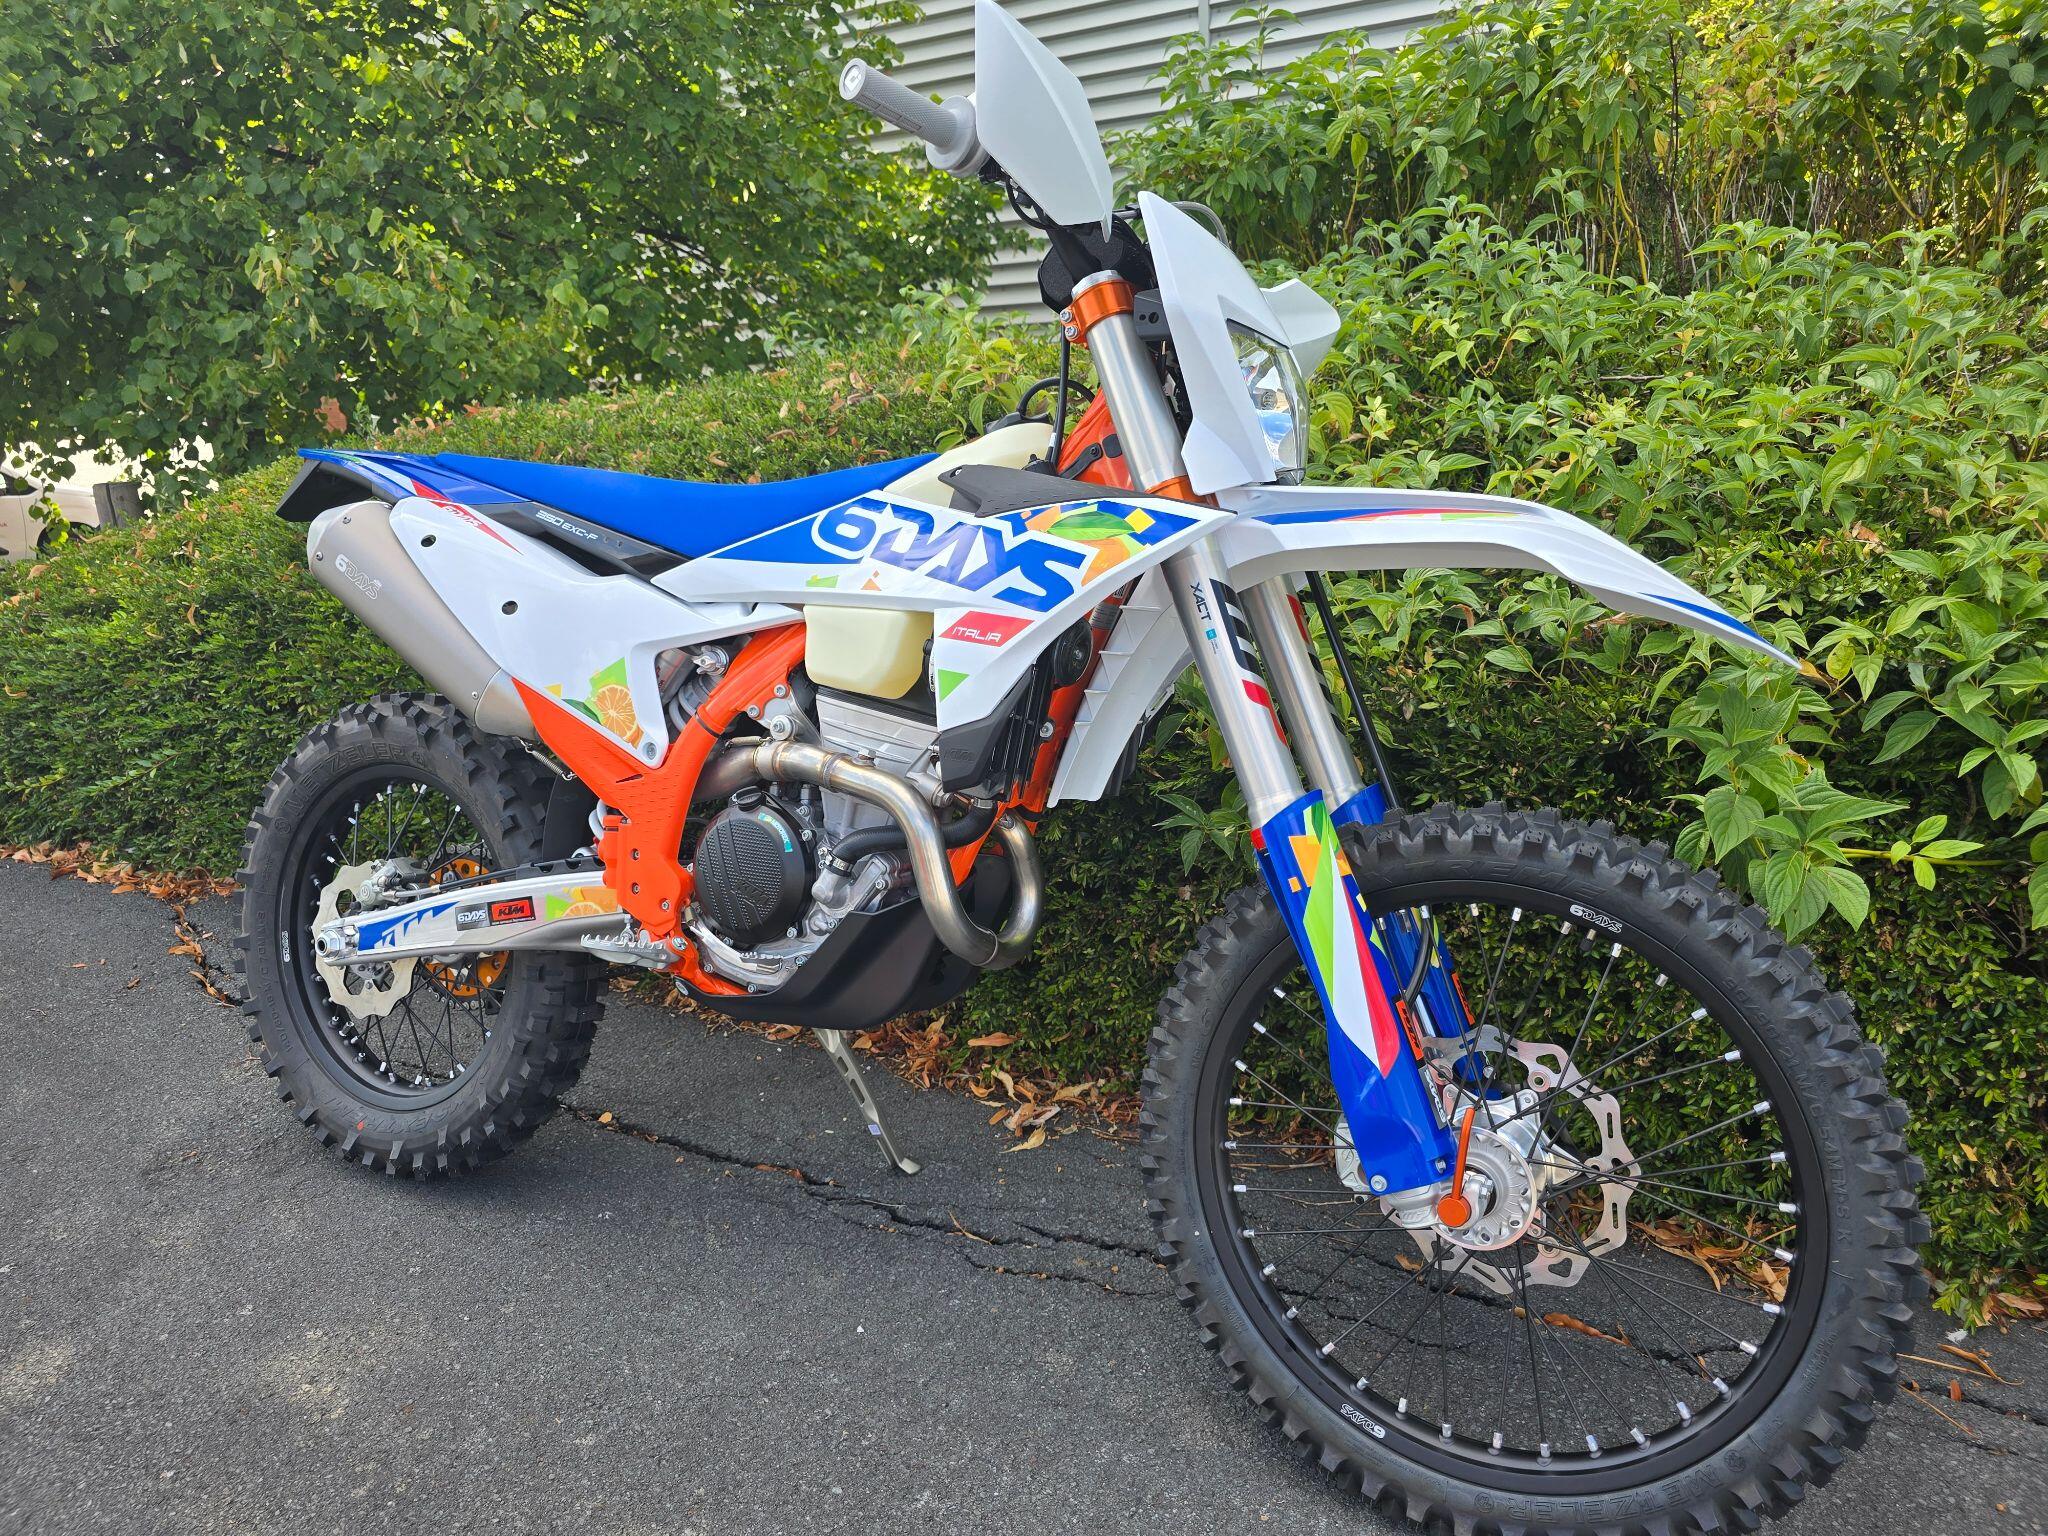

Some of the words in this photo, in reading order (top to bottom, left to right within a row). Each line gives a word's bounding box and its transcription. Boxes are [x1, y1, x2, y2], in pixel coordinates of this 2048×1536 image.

[535, 509, 564, 526] 350
[561, 522, 599, 540] EXC-F
[814, 496, 1089, 613] 6DAYS
[335, 553, 382, 600] 6DAYS
[1190, 581, 1212, 621] XACT
[952, 626, 1002, 643] ITALIA
[1358, 858, 1609, 899] XTREME
[457, 909, 486, 922] 6DAYS
[497, 904, 525, 917] KTM
[1569, 904, 1623, 934] 6DAYS
[281, 930, 292, 963] 6DAYS
[1340, 1403, 1386, 1439] 6DAYS
